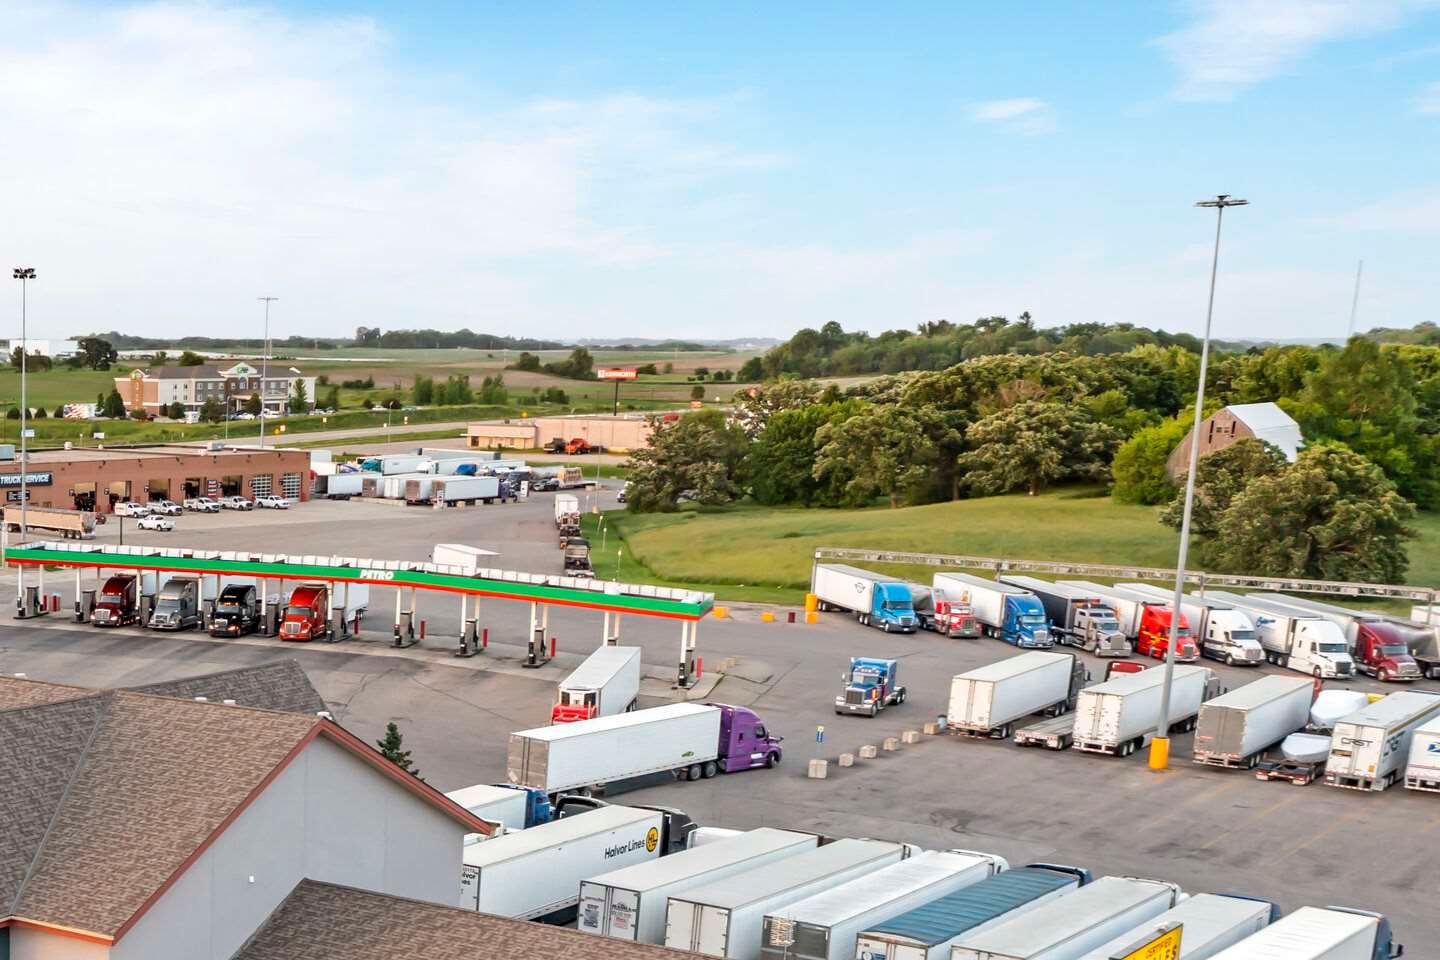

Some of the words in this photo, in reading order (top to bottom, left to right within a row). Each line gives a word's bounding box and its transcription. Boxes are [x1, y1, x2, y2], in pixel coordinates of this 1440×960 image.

[0, 475, 21, 484] TRUCK
[23, 473, 50, 483] ERVICE
[359, 569, 395, 581] PETRO
[604, 845, 628, 860] Halvor
[628, 839, 645, 852] Lines
